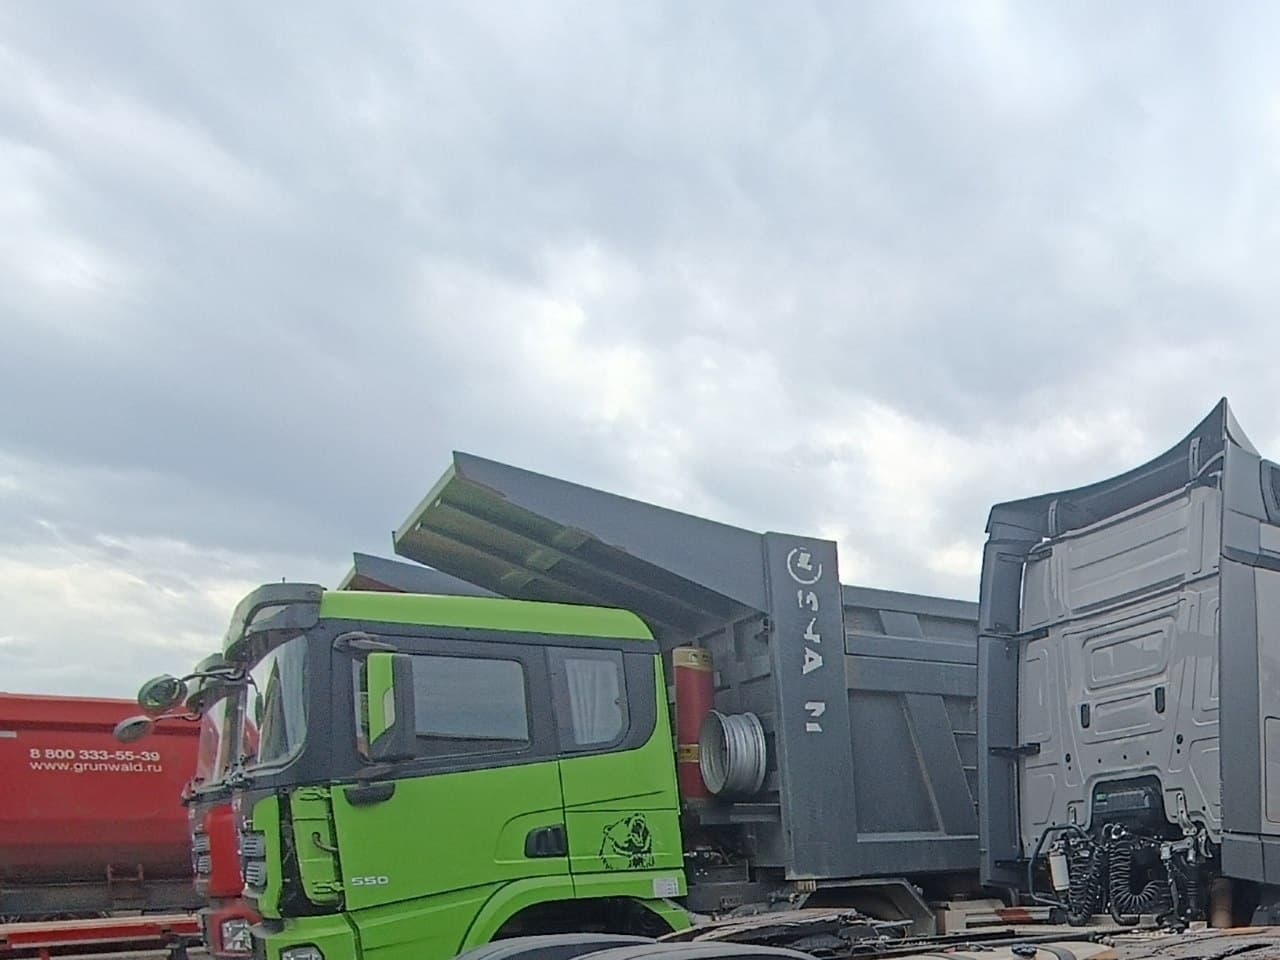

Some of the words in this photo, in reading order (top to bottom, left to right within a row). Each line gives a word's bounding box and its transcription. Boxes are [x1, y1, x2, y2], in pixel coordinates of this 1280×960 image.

[30, 748, 41, 759] 8
[45, 748, 75, 760] 800
[79, 749, 160, 762] 333-55-39
[30, 761, 162, 773] www.grunwald.ru
[351, 875, 389, 886] 550
